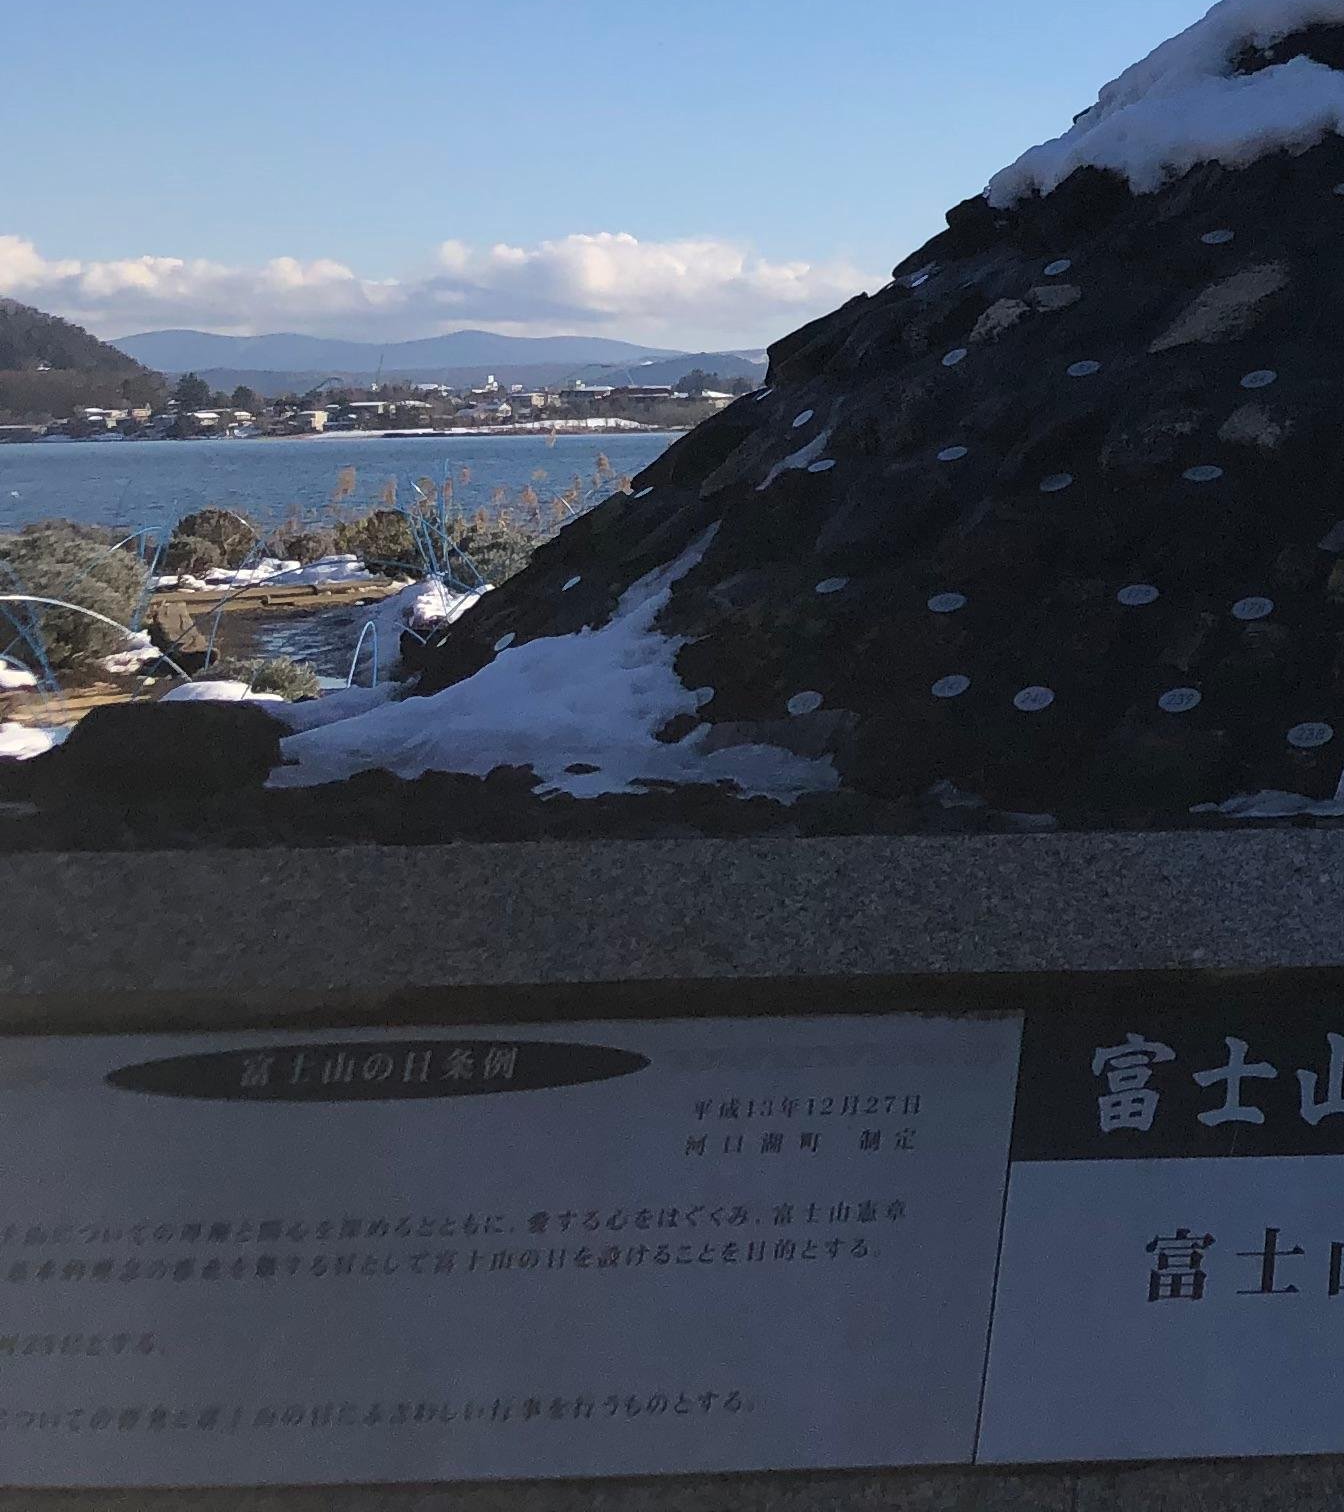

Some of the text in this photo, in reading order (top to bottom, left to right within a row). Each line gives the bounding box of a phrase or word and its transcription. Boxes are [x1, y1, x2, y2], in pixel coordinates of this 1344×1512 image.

[241, 1046, 517, 1088] 富士山の日条例
[693, 1093, 922, 1120] 平成13年12月27日
